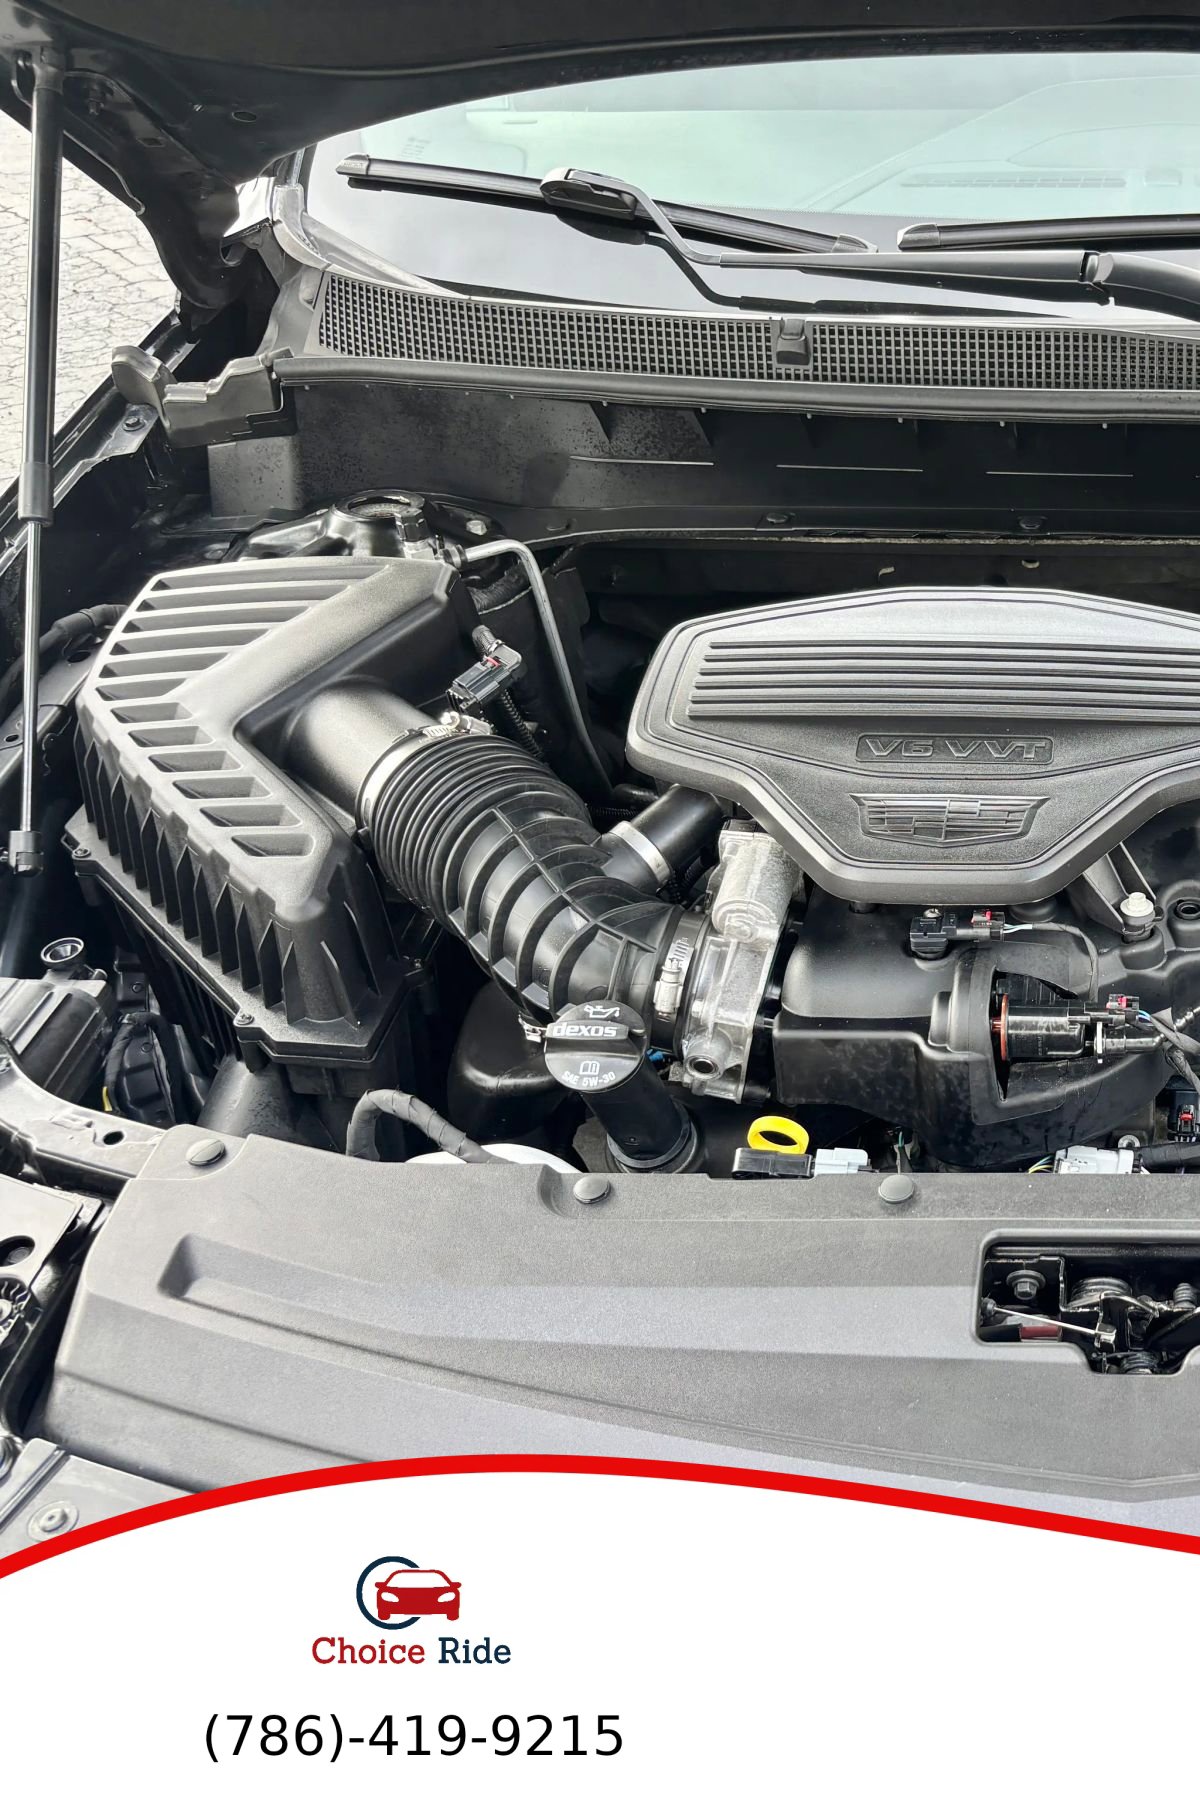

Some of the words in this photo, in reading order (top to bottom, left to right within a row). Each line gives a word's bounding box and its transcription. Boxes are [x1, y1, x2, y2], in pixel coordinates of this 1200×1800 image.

[865, 738, 934, 758] V6
[945, 740, 1046, 760] VVT
[552, 1021, 618, 1037] dexos
[562, 1071, 579, 1084] SAE
[582, 1071, 615, 1087] 5W-30
